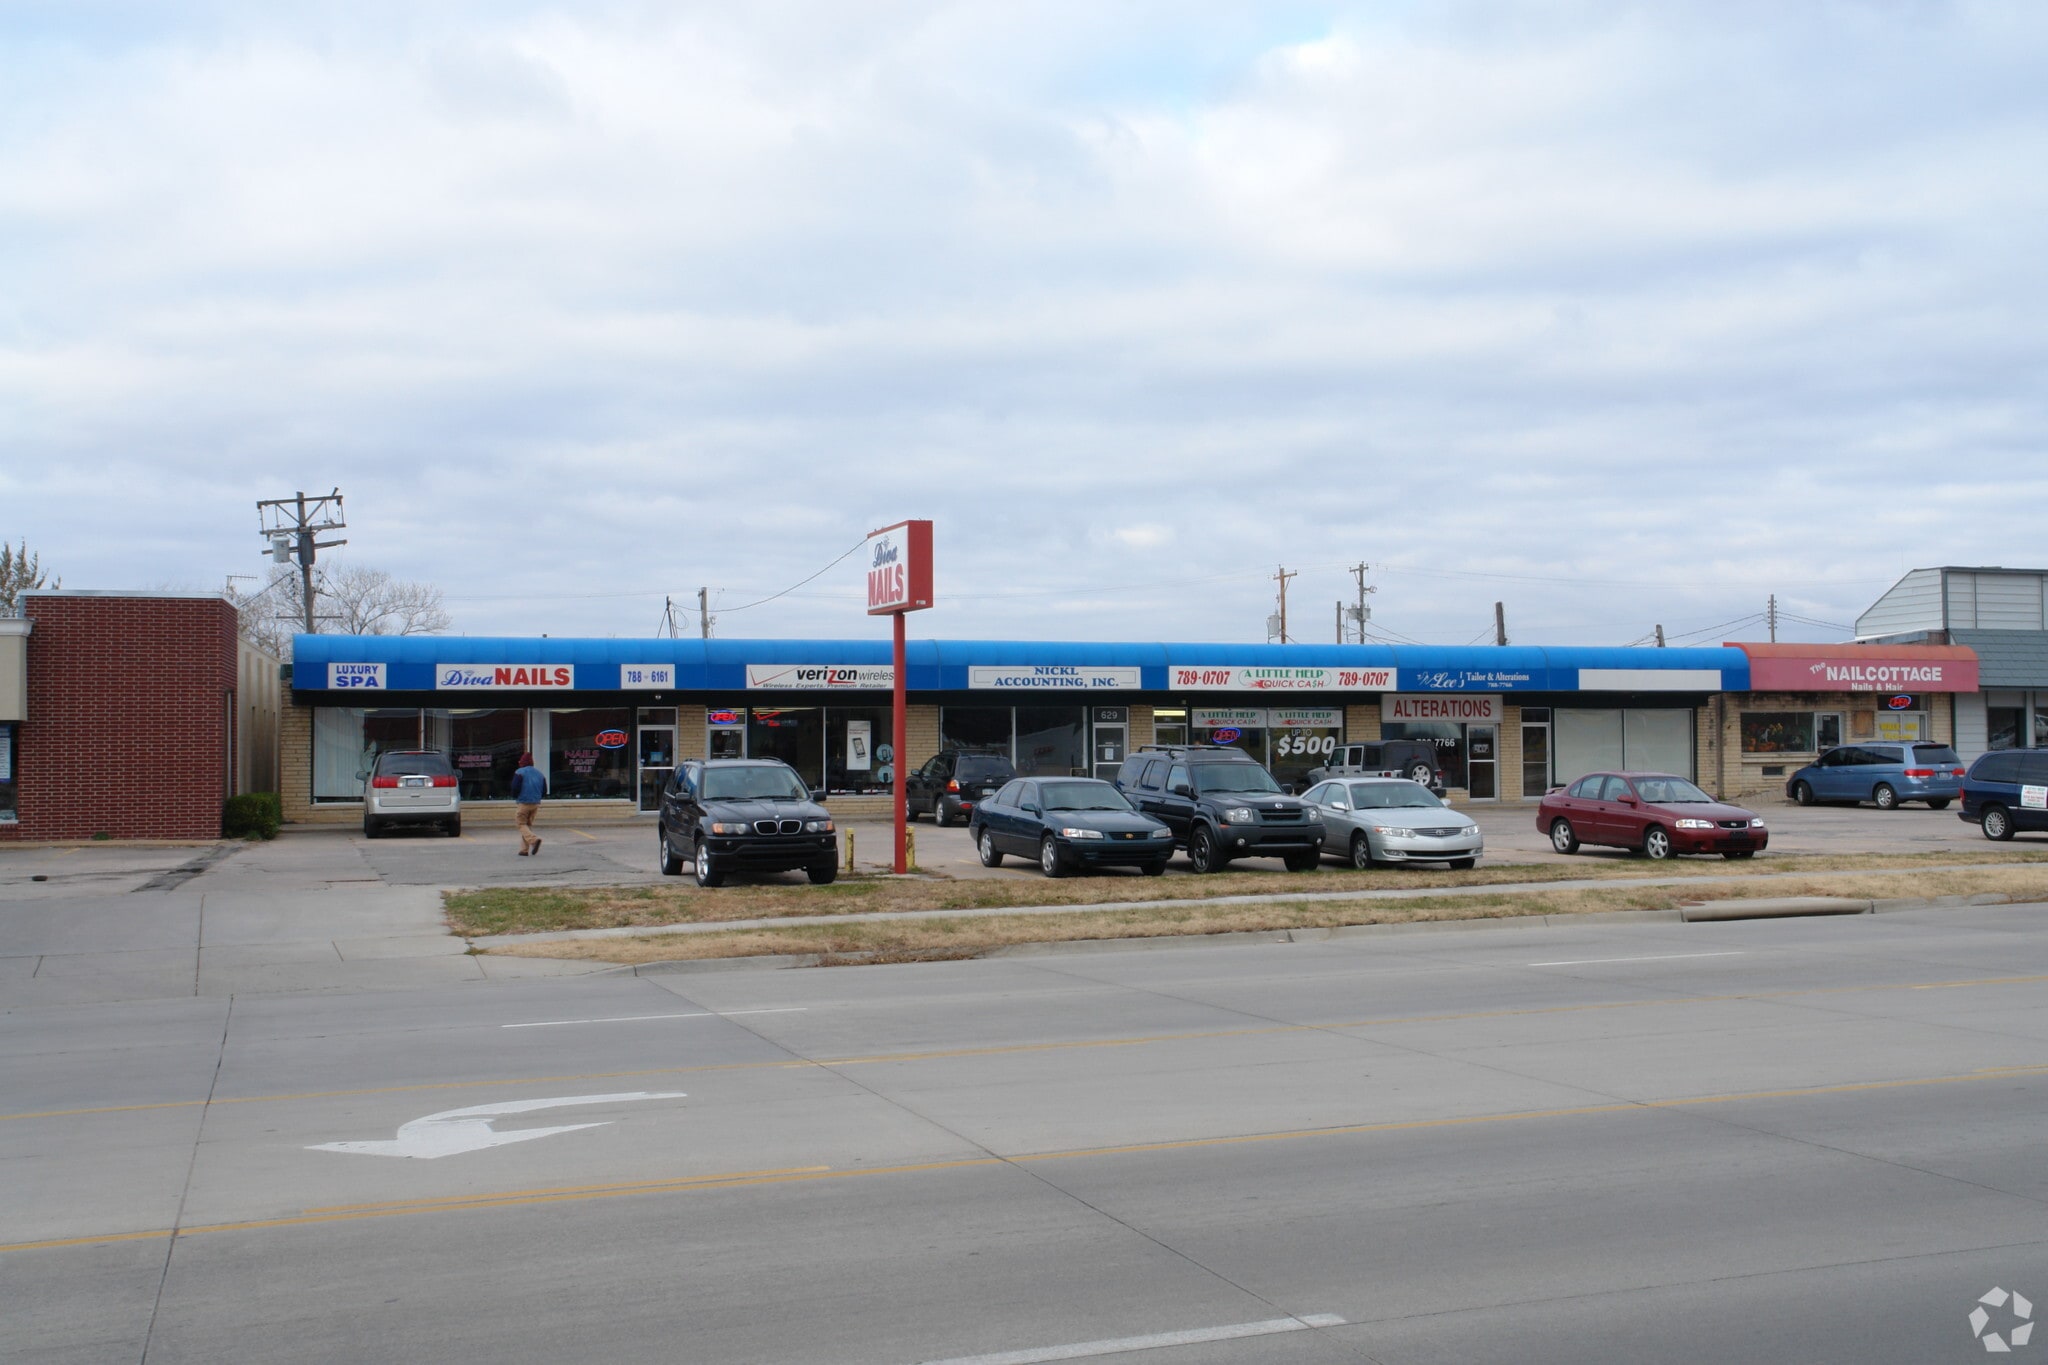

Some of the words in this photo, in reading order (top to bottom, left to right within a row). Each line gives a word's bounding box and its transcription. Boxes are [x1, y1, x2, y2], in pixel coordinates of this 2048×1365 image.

[873, 542, 898, 568] Diva
[868, 563, 904, 606] NAILS
[336, 665, 378, 674] LUXURY
[1034, 667, 1078, 676] NICKL
[1810, 662, 1826, 674] The
[440, 668, 494, 686] Diva
[495, 668, 570, 686] NAILS
[652, 671, 669, 682] 6161
[796, 666, 858, 684] verizon
[858, 670, 894, 681] wireles
[1256, 670, 1290, 678] LITTLE
[1296, 670, 1324, 678] HELP
[1466, 672, 1486, 680] Tailor
[1488, 672, 1494, 680] &
[1496, 672, 1530, 680] Alterations
[336, 676, 378, 688] SPA
[994, 678, 1088, 688] ACCOUNTING,
[1092, 678, 1119, 686] INC.
[1852, 682, 1873, 691] Nails
[1876, 682, 1883, 691] &
[1886, 682, 1903, 691] Hair
[1394, 700, 1491, 717] ALTERATIONS
[1101, 712, 1118, 720] 629
[596, 733, 628, 745] OPEN
[1214, 730, 1238, 740] OPEN
[1278, 735, 1335, 756] $500
[1434, 738, 1455, 747] 7766
